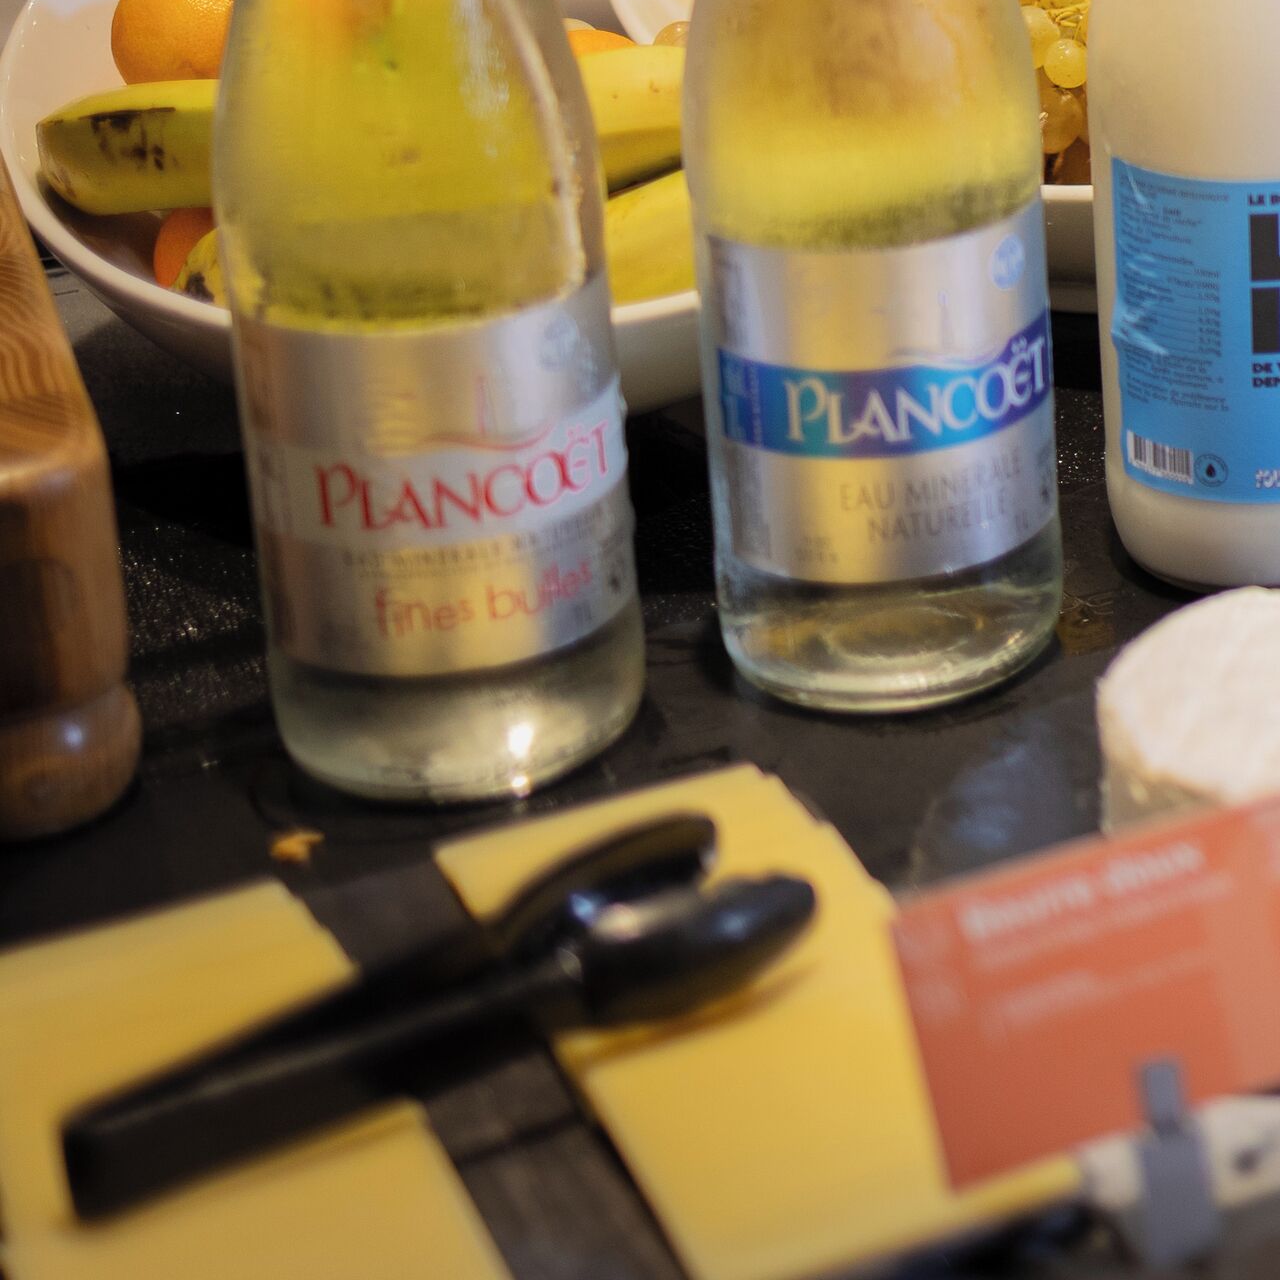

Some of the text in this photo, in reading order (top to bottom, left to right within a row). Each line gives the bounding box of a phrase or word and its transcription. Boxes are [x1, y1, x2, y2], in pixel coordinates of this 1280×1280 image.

[1248, 193, 1265, 205] LE
[1252, 362, 1273, 374] DE
[374, 584, 475, 639] fines
[484, 557, 594, 621] bulles
